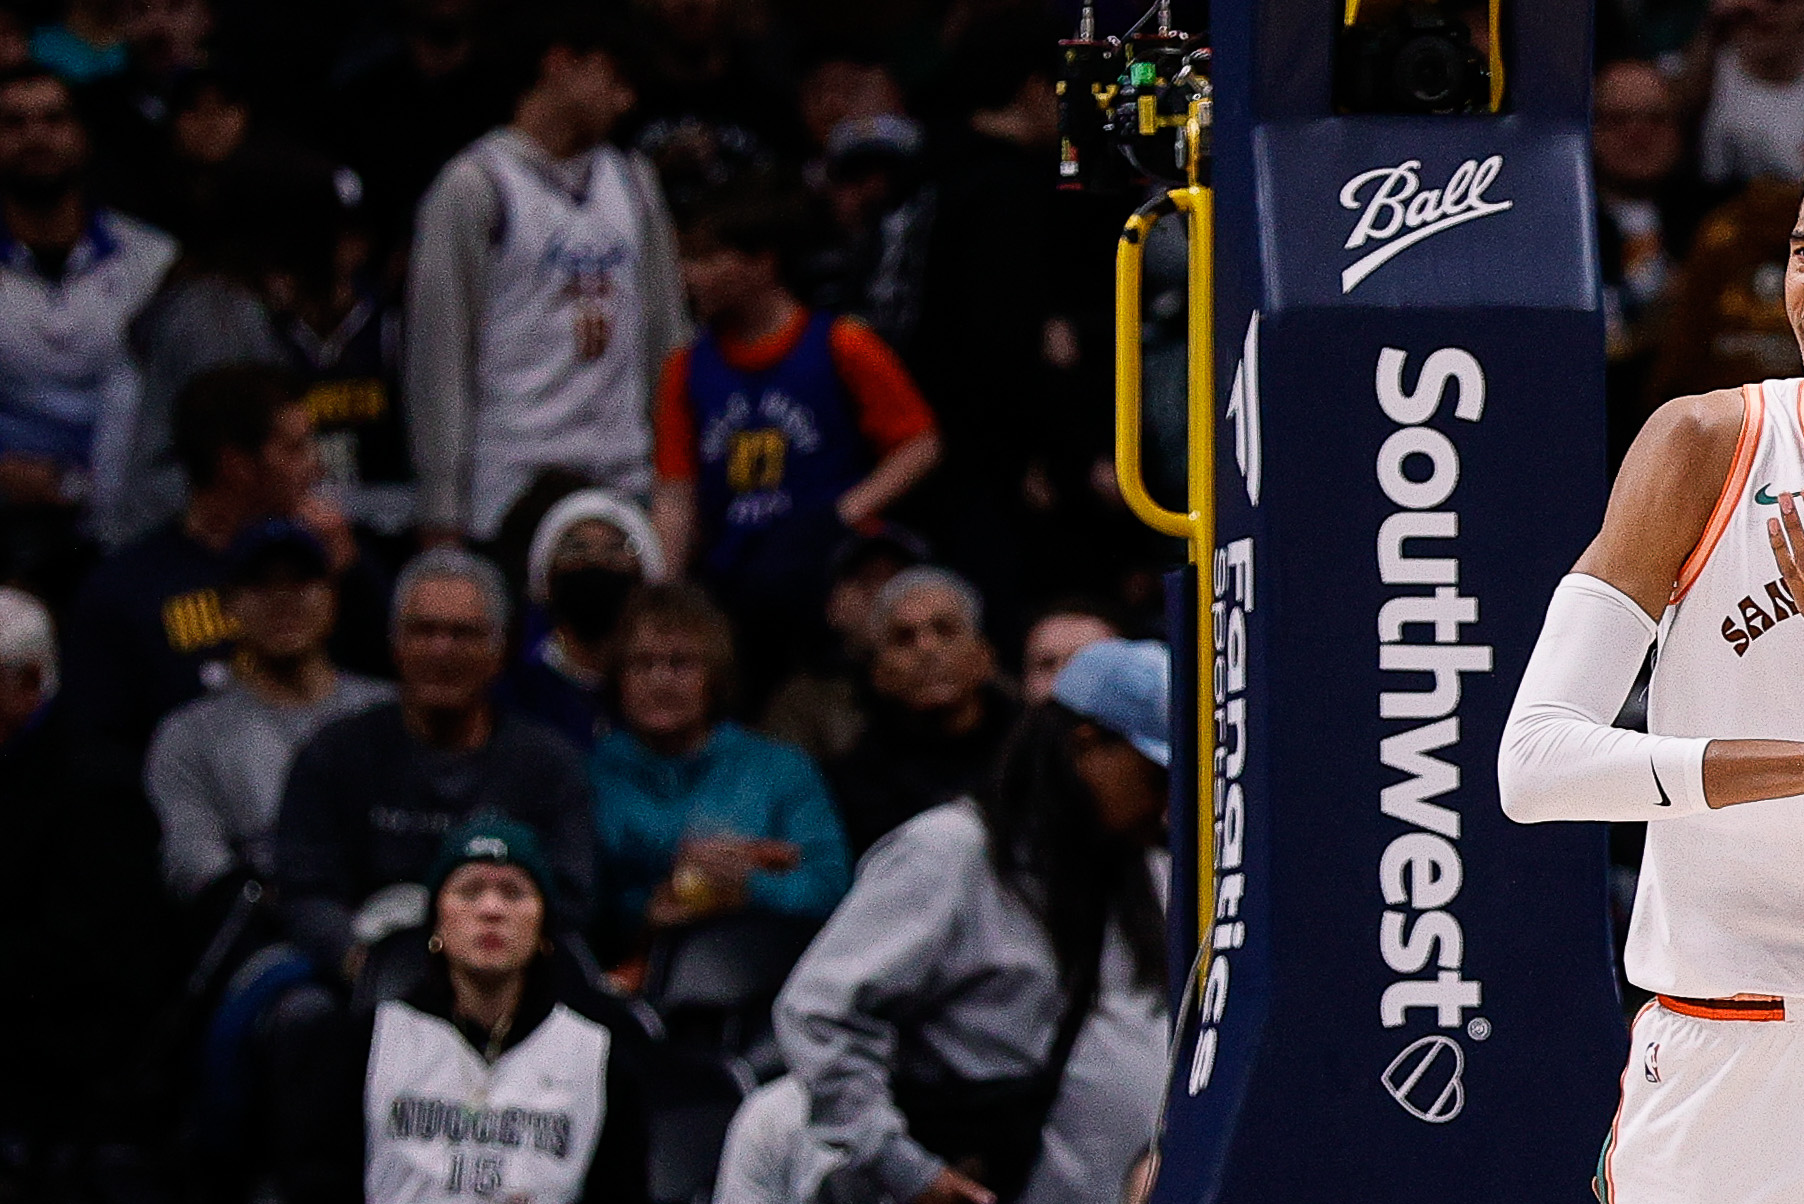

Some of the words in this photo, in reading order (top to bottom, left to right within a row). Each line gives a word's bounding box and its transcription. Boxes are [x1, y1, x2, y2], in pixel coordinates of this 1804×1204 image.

[1339, 153, 1514, 293] Ball
[1187, 536, 1256, 1098] Fanatics
[1375, 346, 1494, 1030] Southwest
